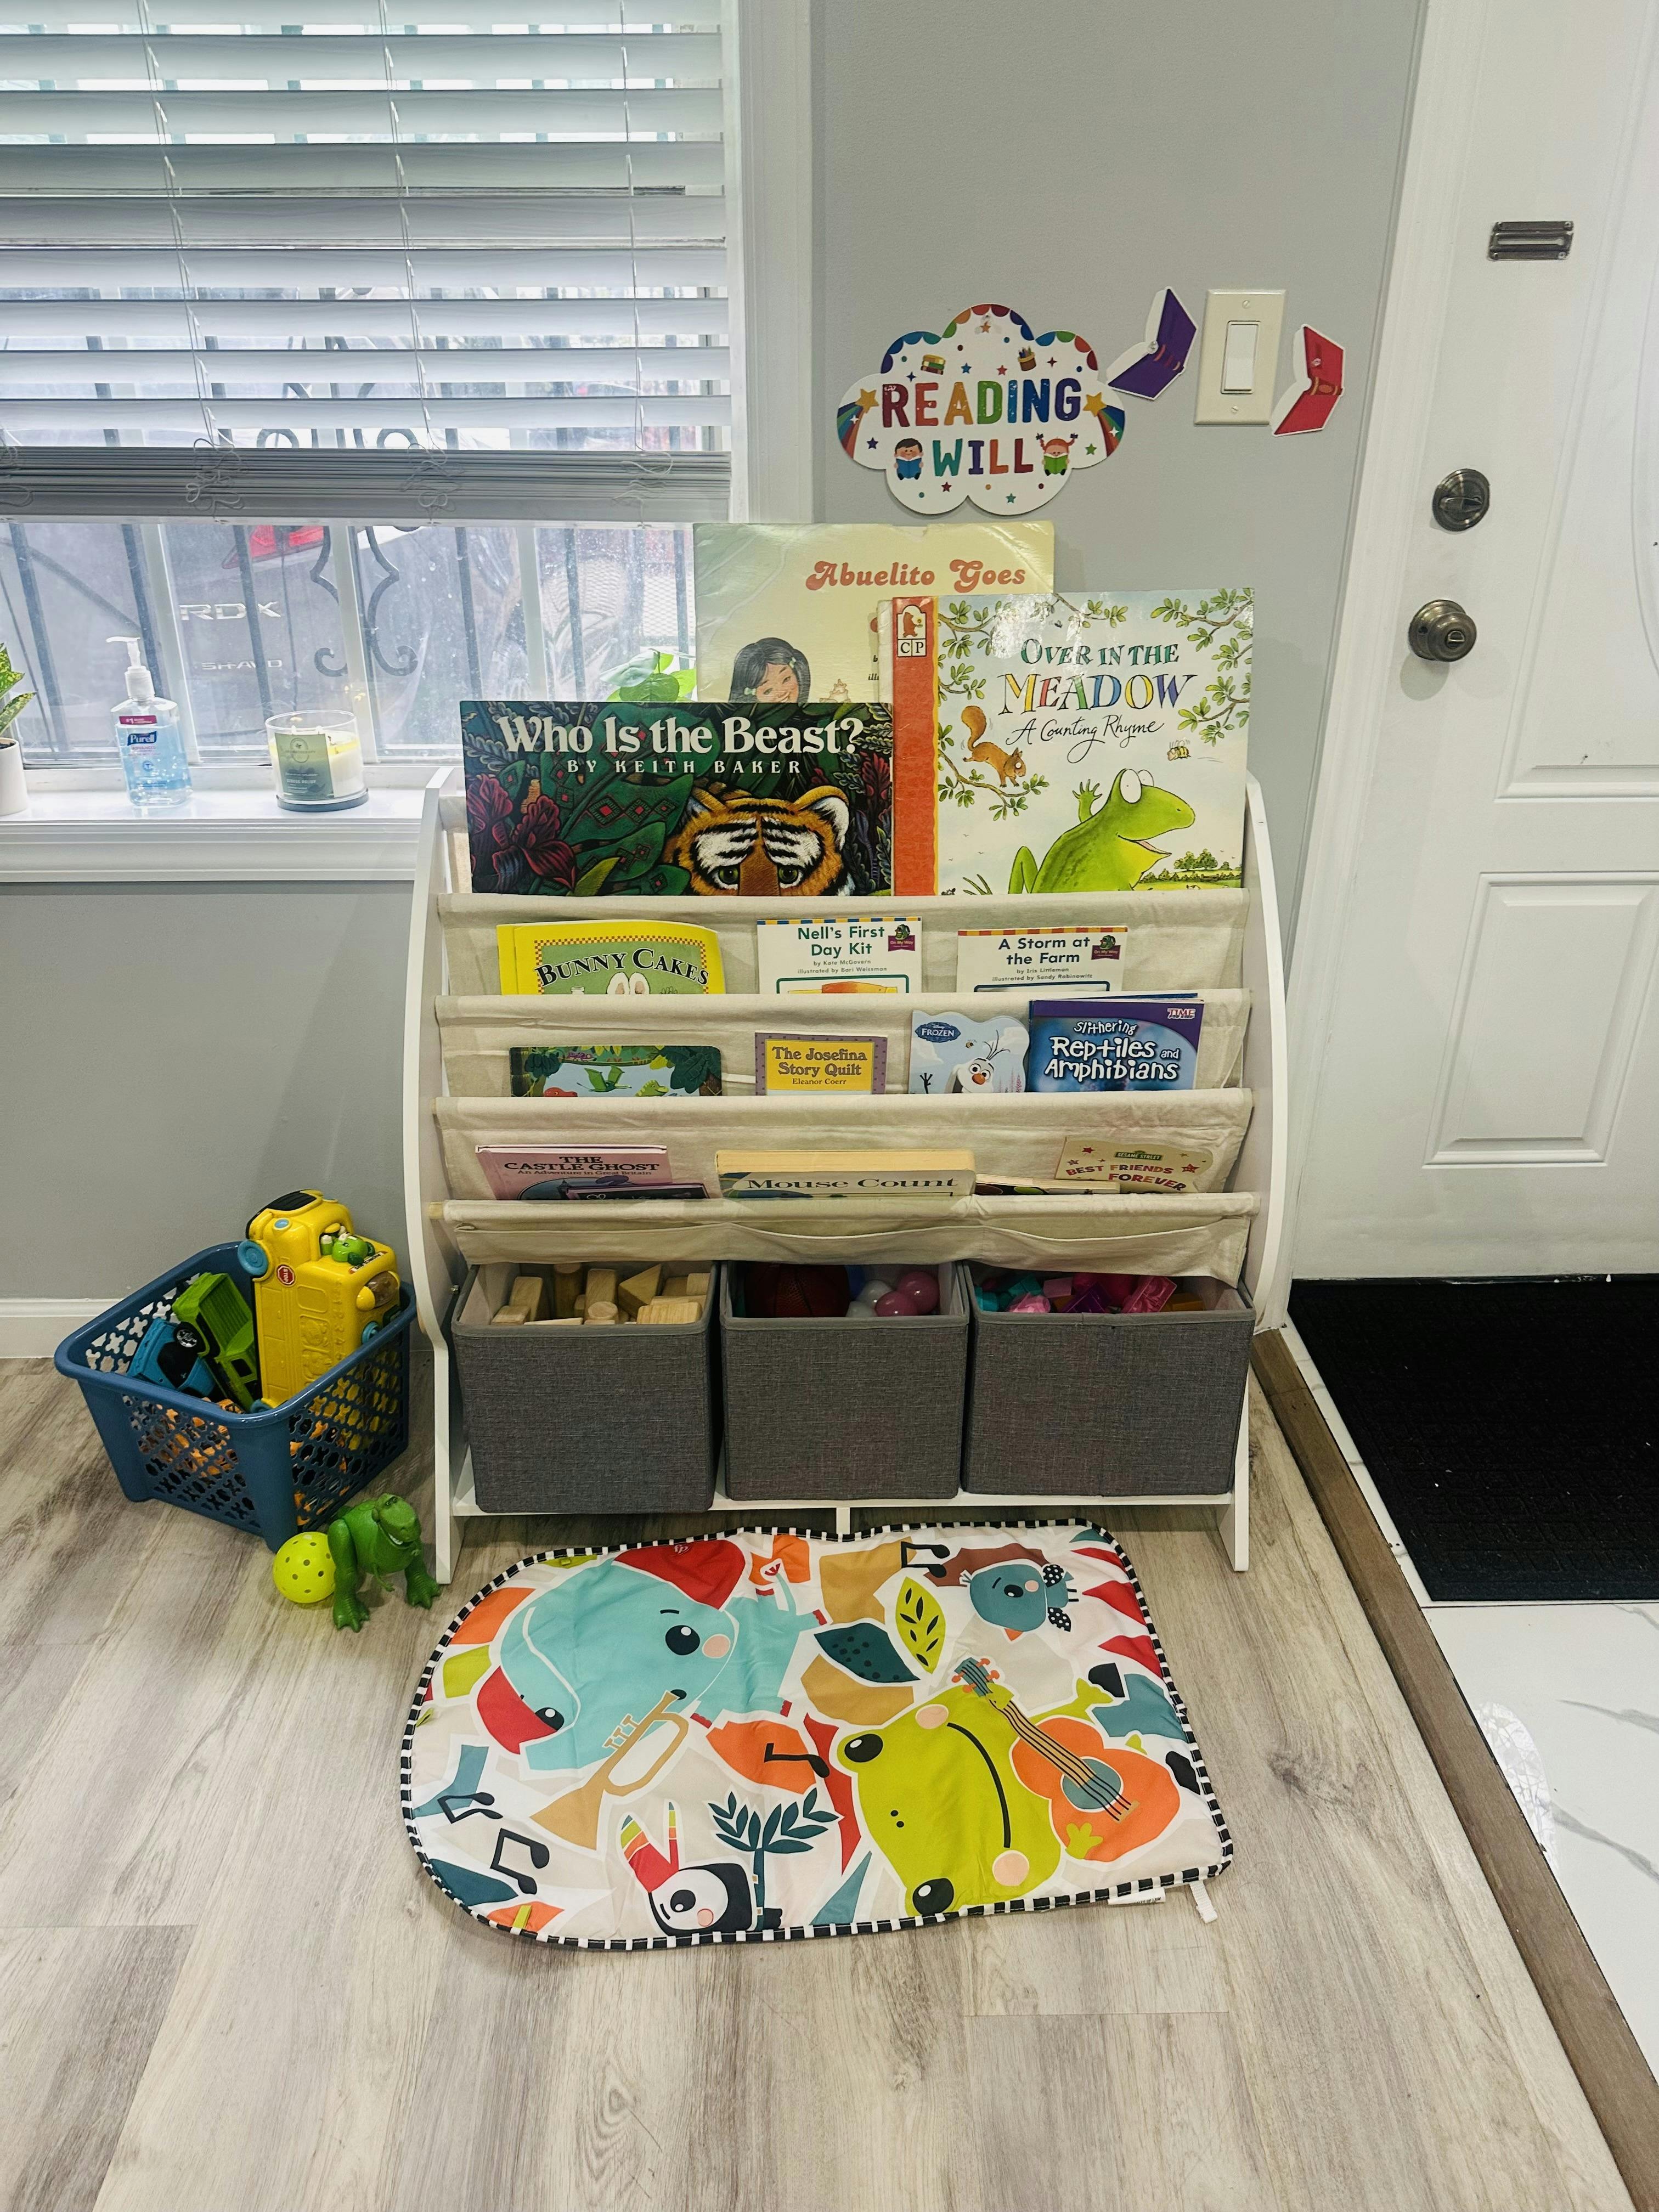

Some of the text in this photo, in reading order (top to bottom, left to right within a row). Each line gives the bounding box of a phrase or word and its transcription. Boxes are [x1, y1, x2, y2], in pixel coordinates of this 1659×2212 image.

[882, 377, 1082, 427] READING
[933, 438, 1034, 476] WILL
[805, 559, 1025, 593] Abuelito Goes
[1021, 638, 1180, 666] OVER IN THE
[998, 673, 1198, 715] MEADOW
[130, 734, 155, 743] Purell
[497, 716, 864, 754] Who Is the Beast?
[1006, 717, 1165, 764] A Counting Rhyme
[567, 759, 802, 774] BY KEITH BAKER
[798, 926, 885, 939] Nell's First
[811, 943, 872, 958] Day Kit
[998, 937, 1090, 950] A Storm at
[1007, 952, 1080, 965] the Farm
[534, 947, 709, 988] BUNNY CAKES
[1167, 1008, 1196, 1019] TIME
[922, 1028, 955, 1037] FROZEN
[772, 1047, 867, 1060] The Josefina
[1049, 1036, 1179, 1059] Reptiles and
[778, 1062, 861, 1077] Story Quilt
[1044, 1058, 1178, 1083] Amphibians
[1066, 1164, 1174, 1177] BEST FRIENDS
[747, 1177, 958, 1189] Mouse Count
[1108, 1172, 1187, 1192] FOREVER
